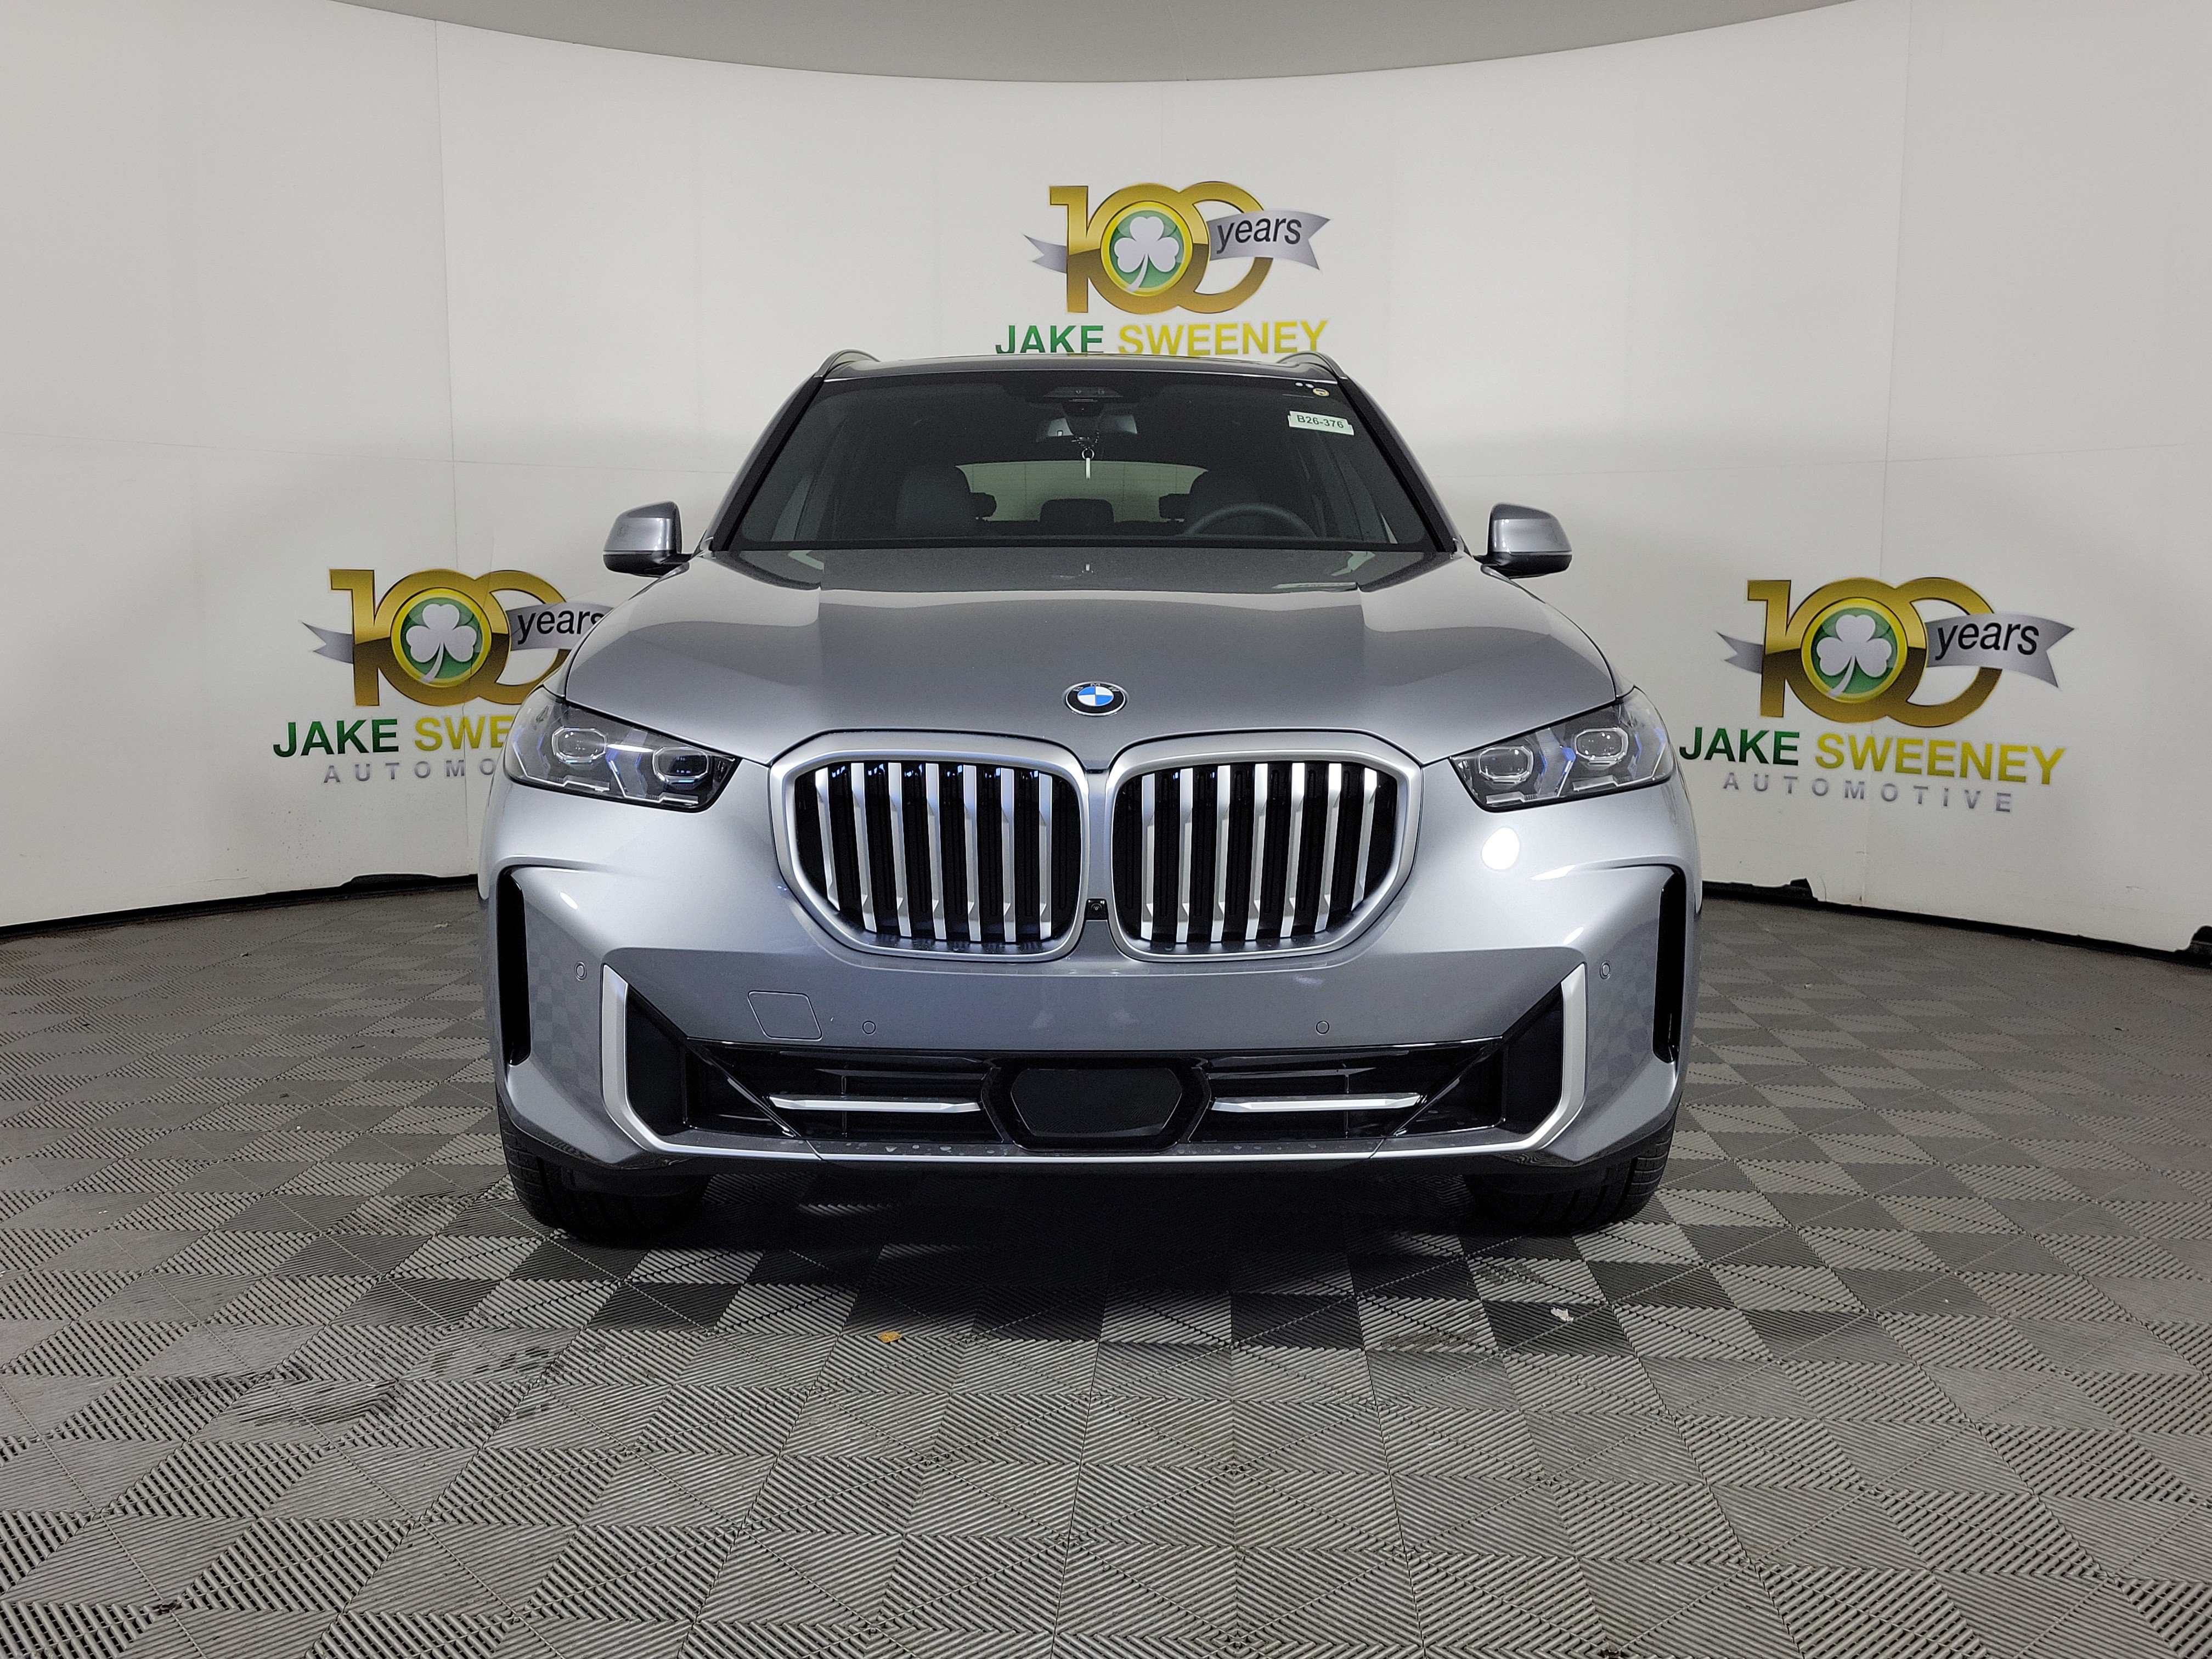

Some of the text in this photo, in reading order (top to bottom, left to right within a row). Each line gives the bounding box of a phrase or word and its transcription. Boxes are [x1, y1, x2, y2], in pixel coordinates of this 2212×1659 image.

[1049, 180, 1302, 315] 100 years
[995, 320, 1328, 357] JAKE SWEENEY
[1296, 414, 1344, 428] B26-376
[1747, 576, 2039, 728] 100 years
[273, 718, 399, 758] JAKE
[1679, 726, 2066, 785] JAKE SWEENEY
[1723, 771, 2012, 813] AUTOMOTIVE
